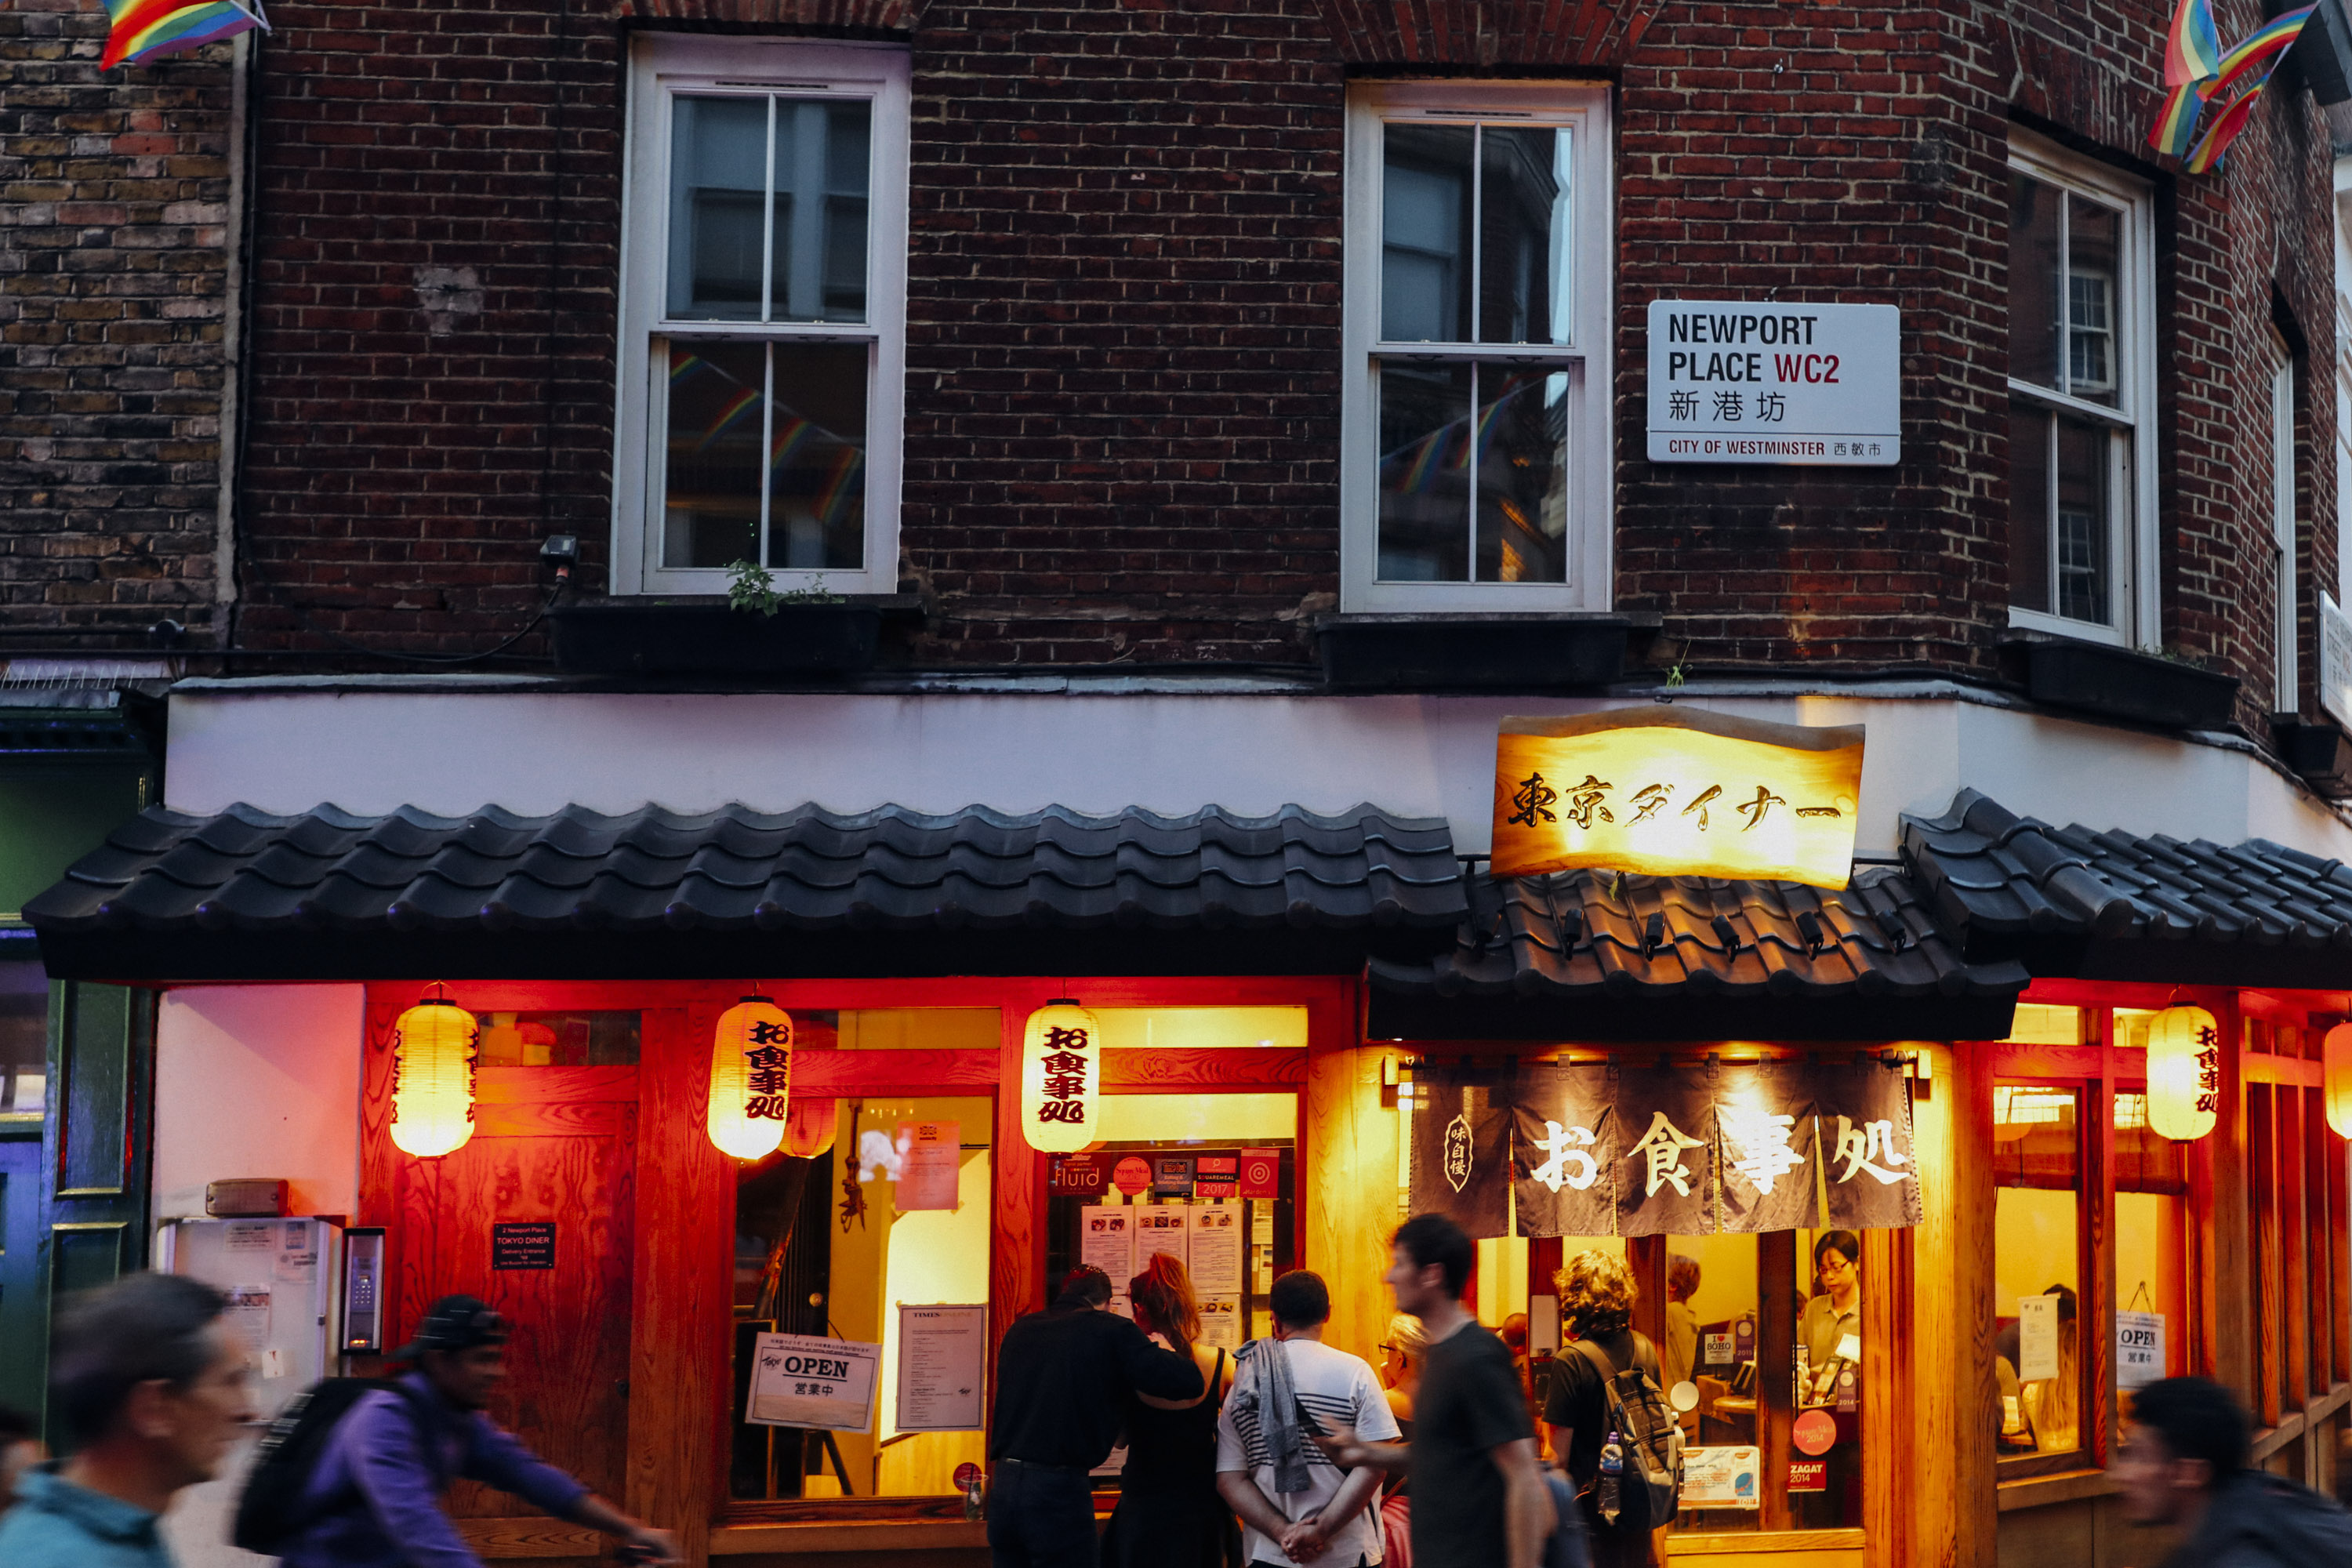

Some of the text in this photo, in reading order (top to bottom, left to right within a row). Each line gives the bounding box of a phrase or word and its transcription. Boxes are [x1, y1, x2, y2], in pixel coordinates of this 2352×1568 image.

[1669, 314, 1818, 345] NEWPORT
[1669, 351, 1840, 383] PLACE WC2
[1668, 390, 1786, 422] 新港坊
[1669, 440, 1825, 456] CITY OF WESTMINSTER
[1834, 441, 1881, 457] 西敏市
[1507, 771, 1842, 832] 東京ダイナー
[744, 1021, 789, 1121] お食事処
[1038, 1026, 1088, 1124] お食事処
[1530, 1110, 1911, 1198] お食事処
[1055, 1167, 1099, 1187] fluid
[1203, 1184, 1228, 1194] 2017
[2121, 1329, 2155, 1347] OPEN
[785, 1356, 849, 1378] OPEN
[2128, 1352, 2151, 1364] 営業中
[795, 1381, 833, 1396] 営業中
[1806, 1434, 1824, 1443] 2014
[1790, 1464, 1823, 1474] ZAGAT
[1790, 1473, 1810, 1483] 2014
